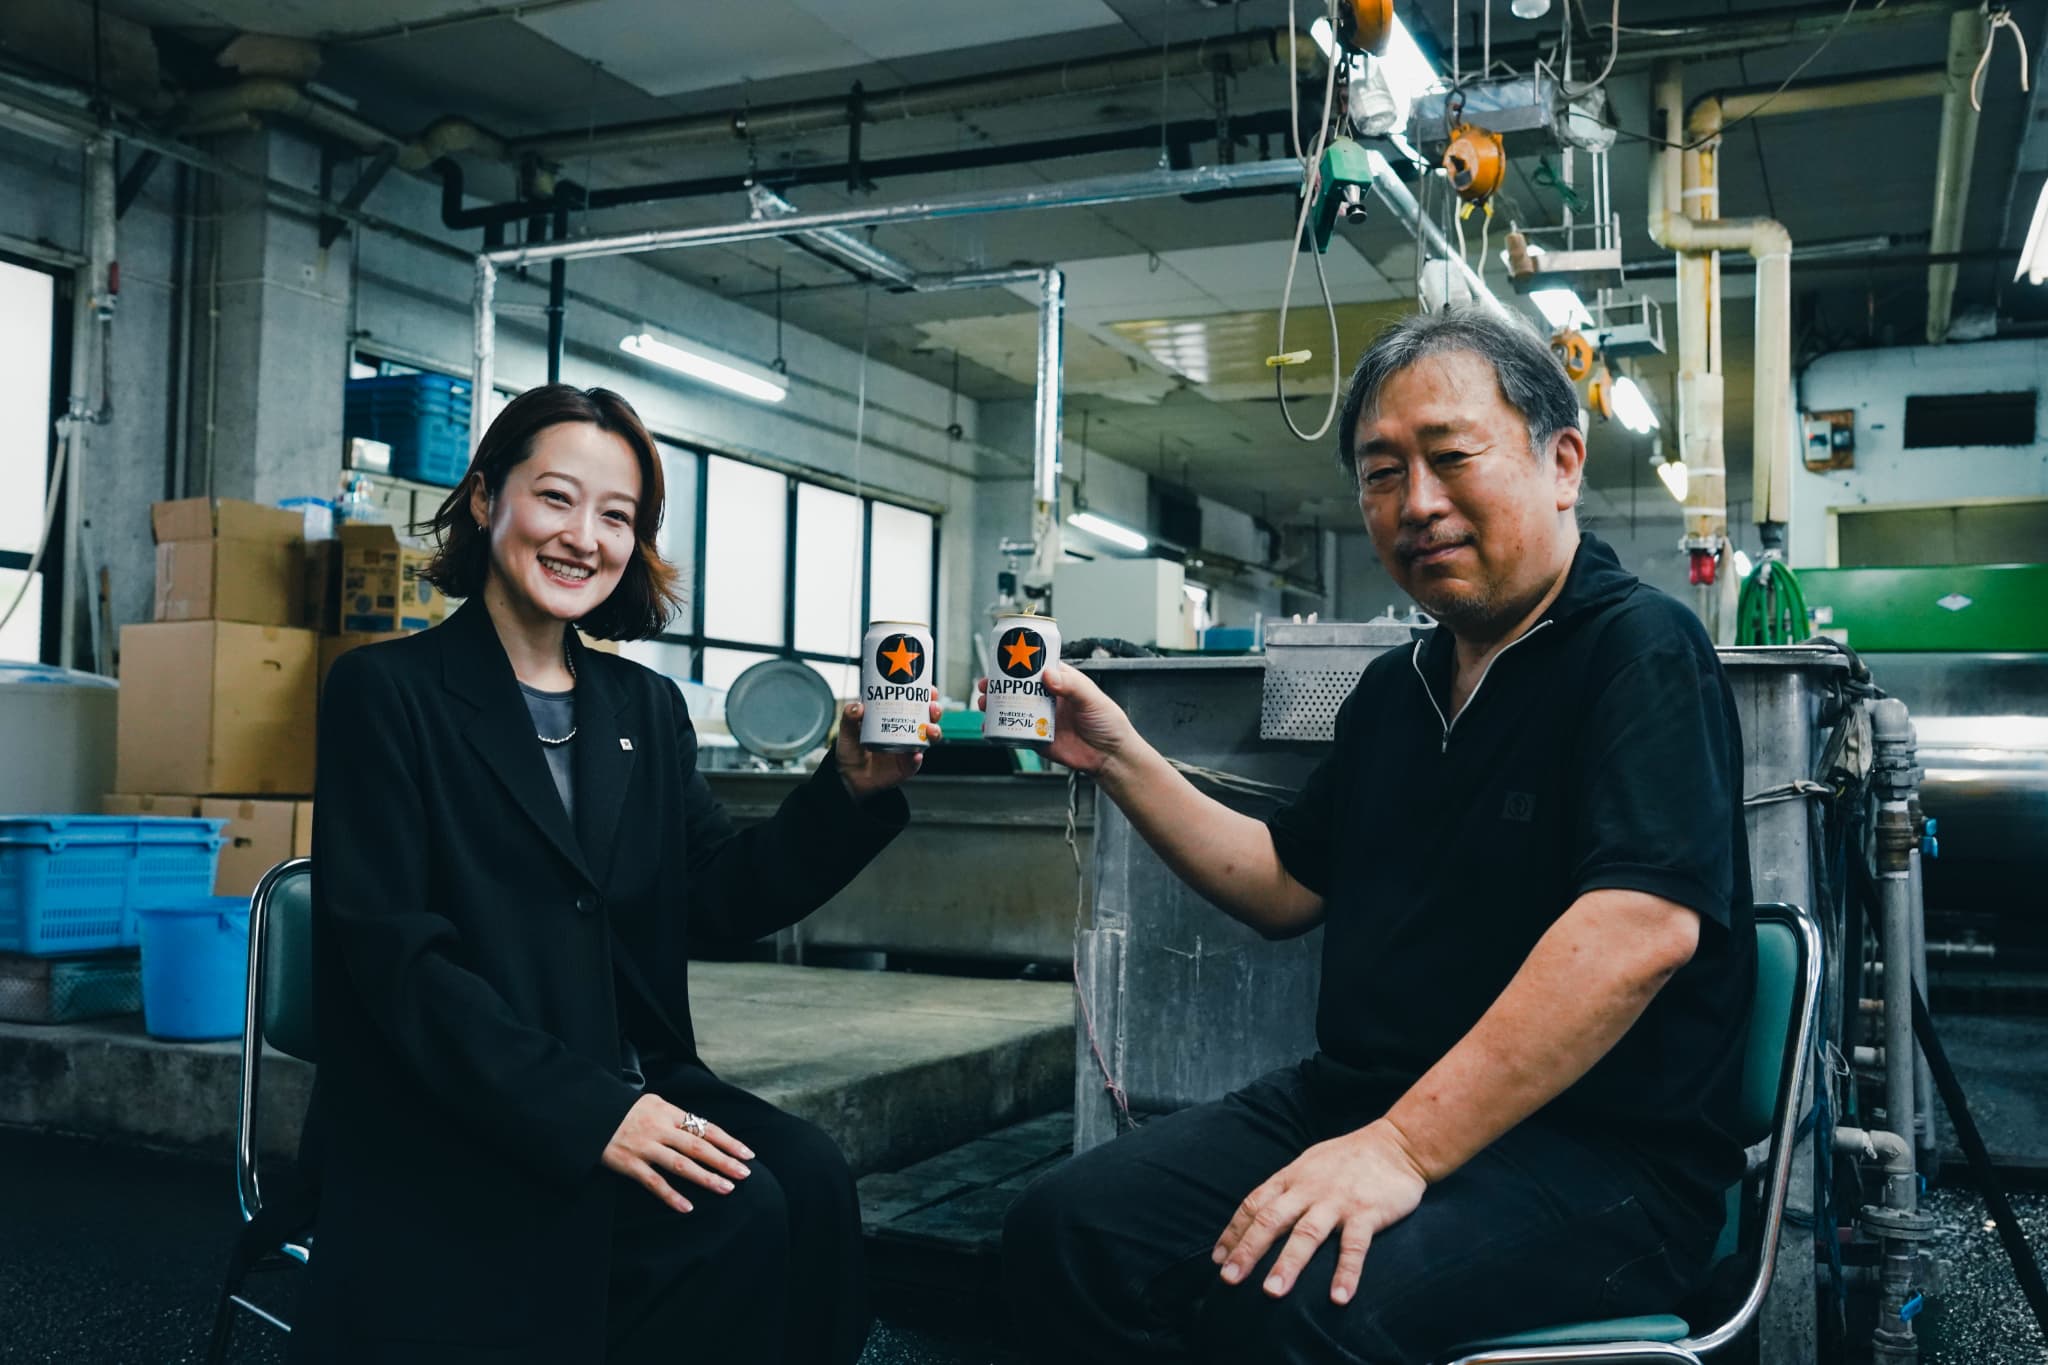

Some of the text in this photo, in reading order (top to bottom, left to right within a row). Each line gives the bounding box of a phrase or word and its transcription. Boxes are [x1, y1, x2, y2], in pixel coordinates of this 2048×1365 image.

[867, 686, 930, 703] SAPPORO
[998, 717, 1034, 728] 黒ラベル
[881, 724, 917, 734] 黒ラベル
